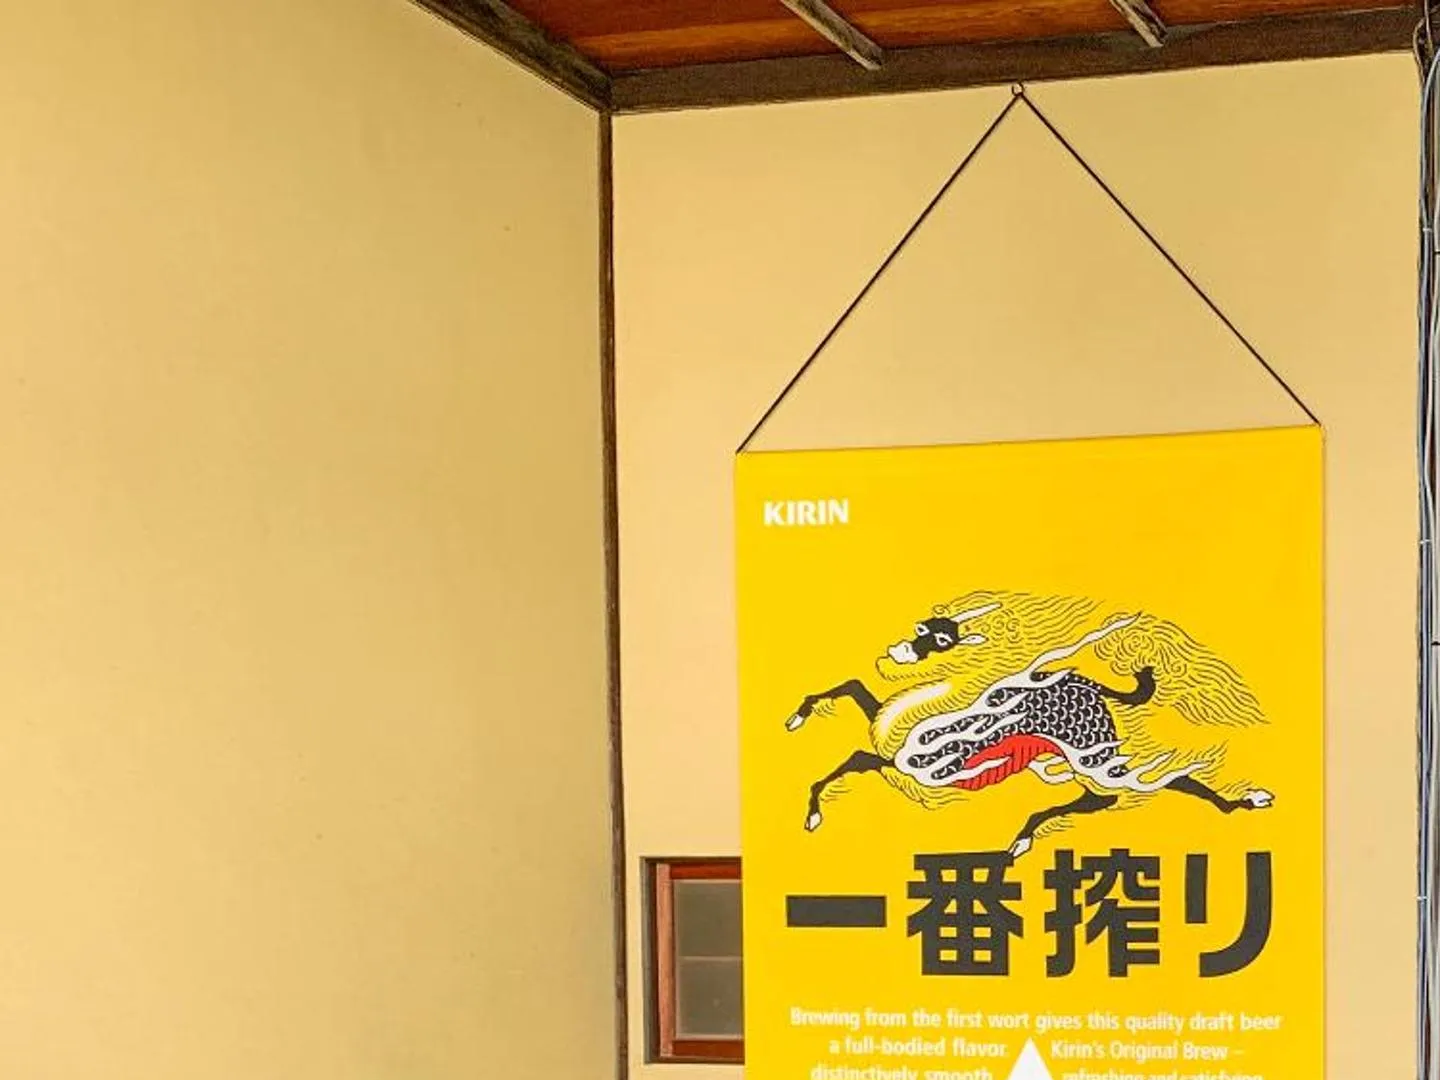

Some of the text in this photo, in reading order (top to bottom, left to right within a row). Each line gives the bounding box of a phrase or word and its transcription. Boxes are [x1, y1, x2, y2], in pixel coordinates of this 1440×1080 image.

[763, 498, 850, 526] KIRIN
[785, 848, 1273, 978] 一番搾り
[790, 1008, 1283, 1034] Brewing from the first wort gives this quality draft beer
[829, 1040, 840, 1054] a
[844, 1037, 946, 1056] full-bodied
[1051, 1040, 1105, 1059] Kirin's
[1110, 1041, 1178, 1064] Original
[1182, 1042, 1229, 1060] Brew
